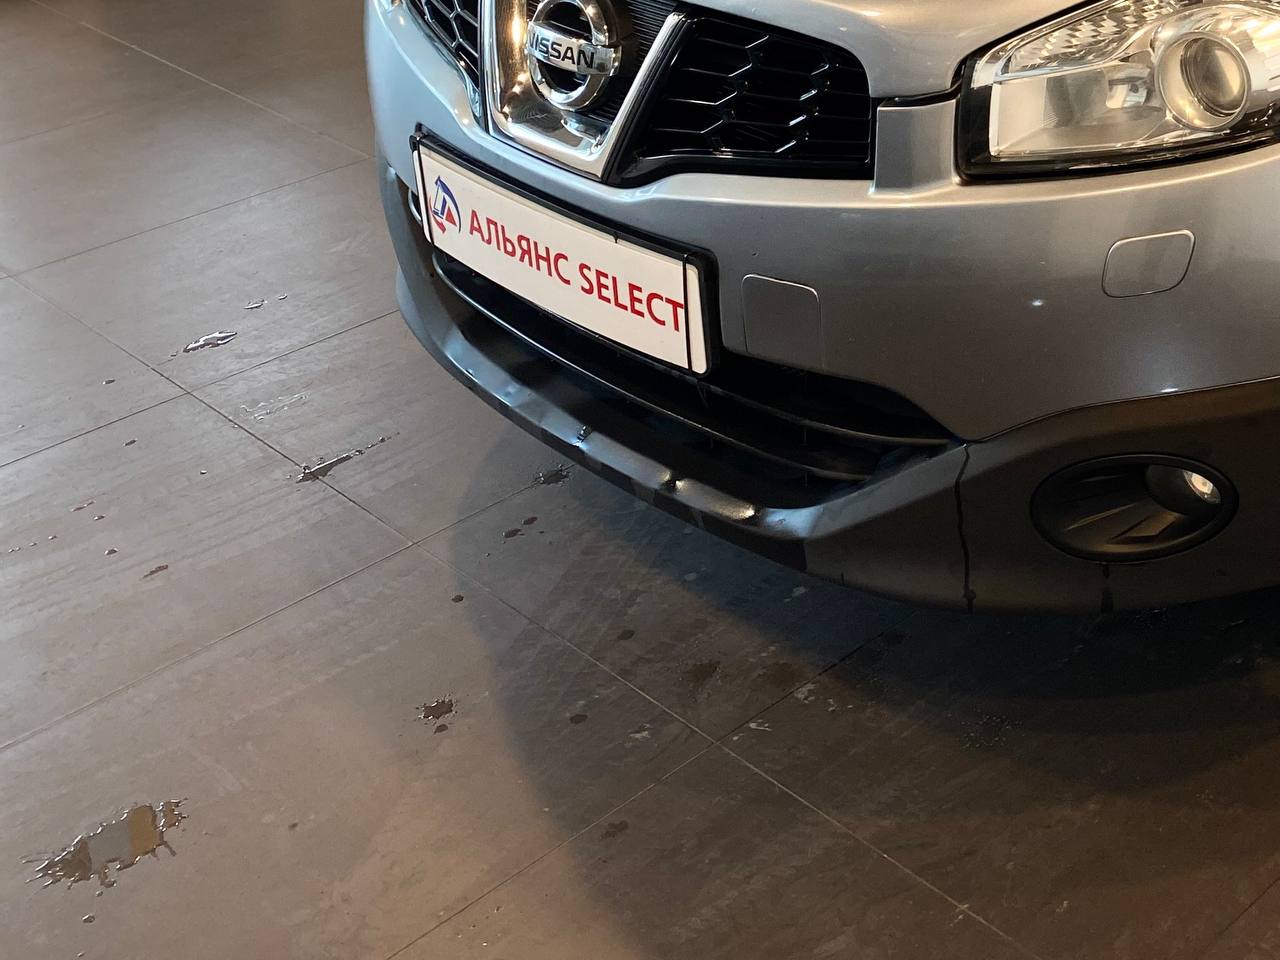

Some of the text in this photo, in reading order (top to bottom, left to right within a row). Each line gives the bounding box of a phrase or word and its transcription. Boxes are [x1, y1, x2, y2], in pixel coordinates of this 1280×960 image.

[528, 31, 595, 69] NISSAN
[469, 209, 685, 333] АЛЬЯНС SELECT
